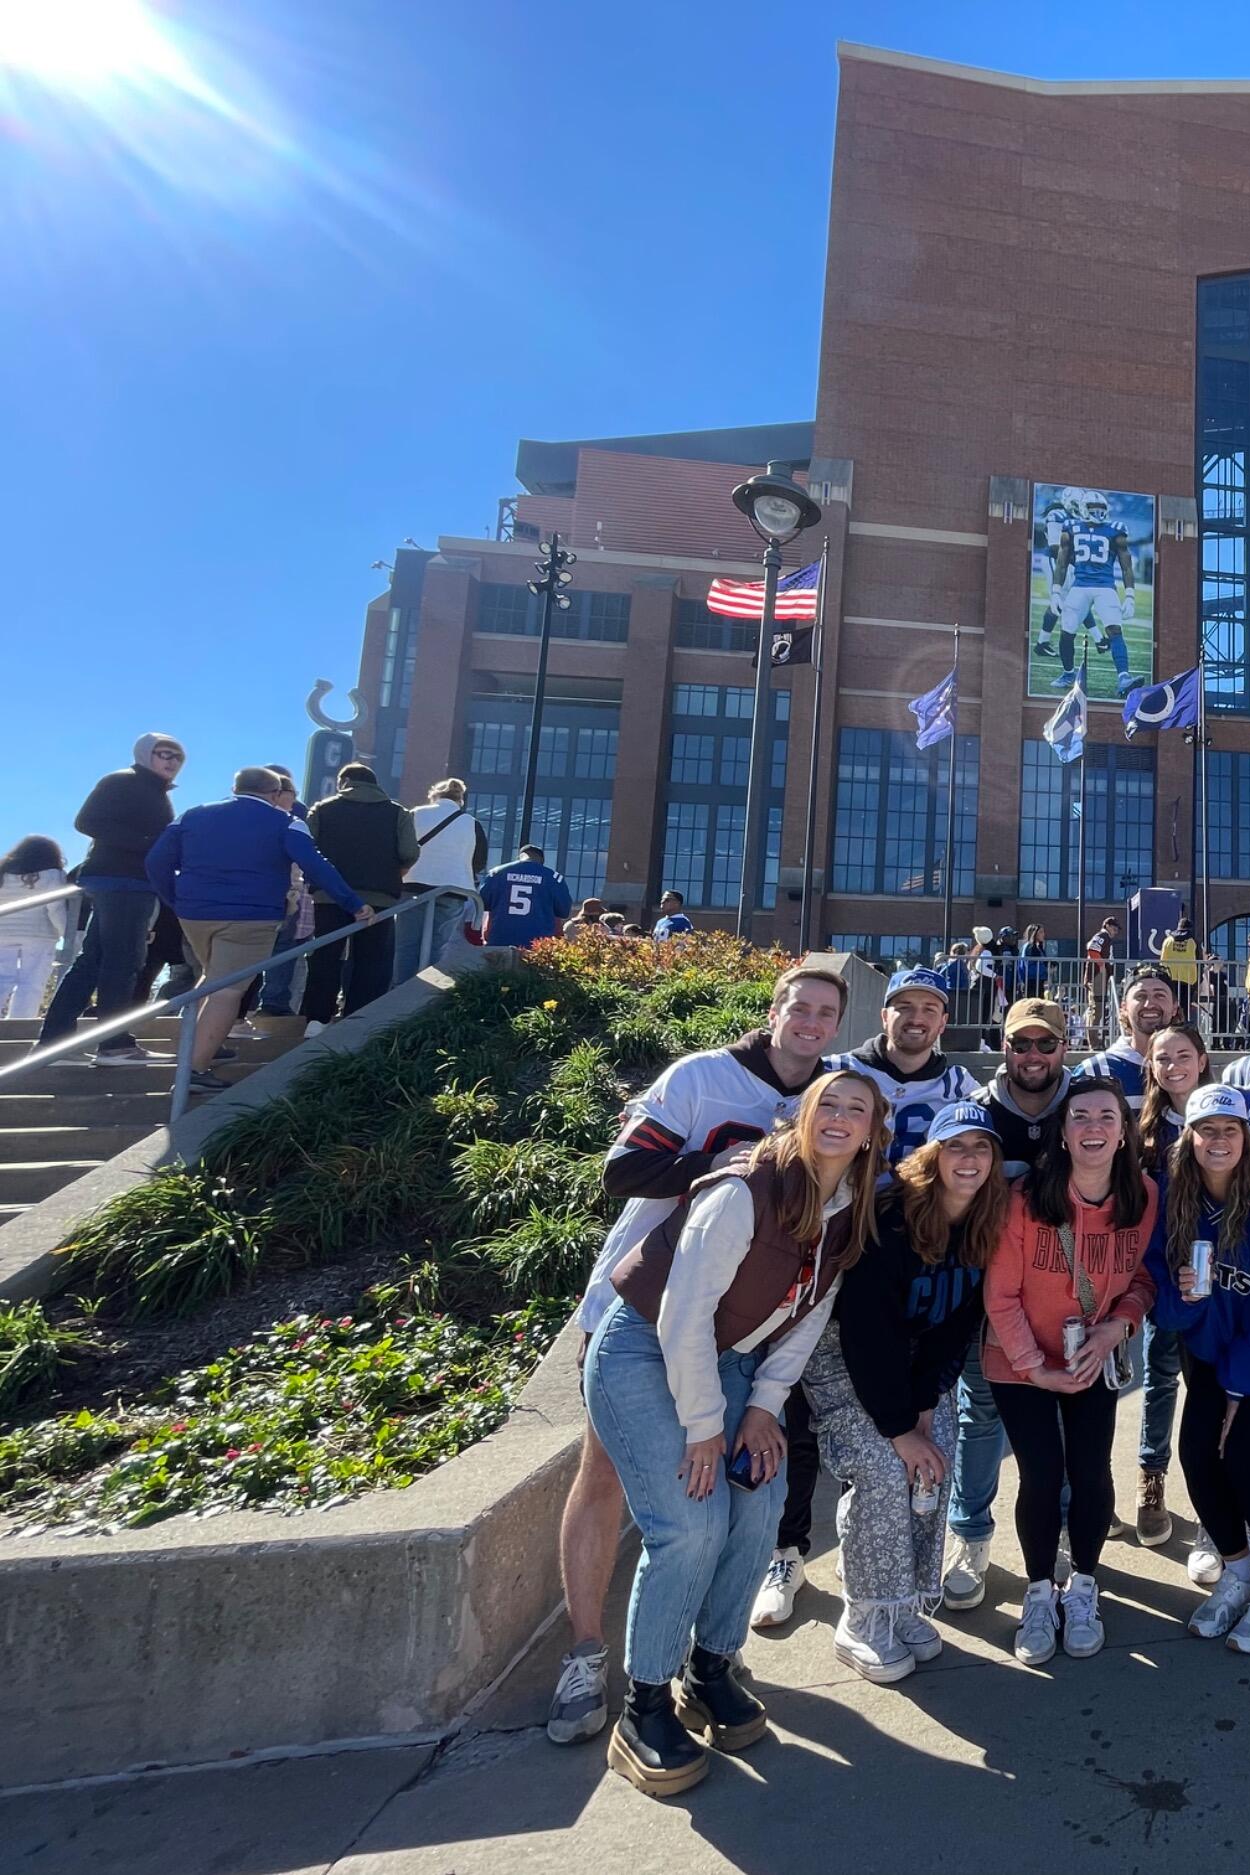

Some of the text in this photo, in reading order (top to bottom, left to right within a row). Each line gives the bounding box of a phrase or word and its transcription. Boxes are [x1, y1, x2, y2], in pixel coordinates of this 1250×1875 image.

[1073, 533, 1110, 564] 53
[508, 885, 533, 916] 5
[955, 1106, 986, 1123] INDY
[1200, 1094, 1236, 1110] Colts
[1032, 1227, 1140, 1274] BRWNS
